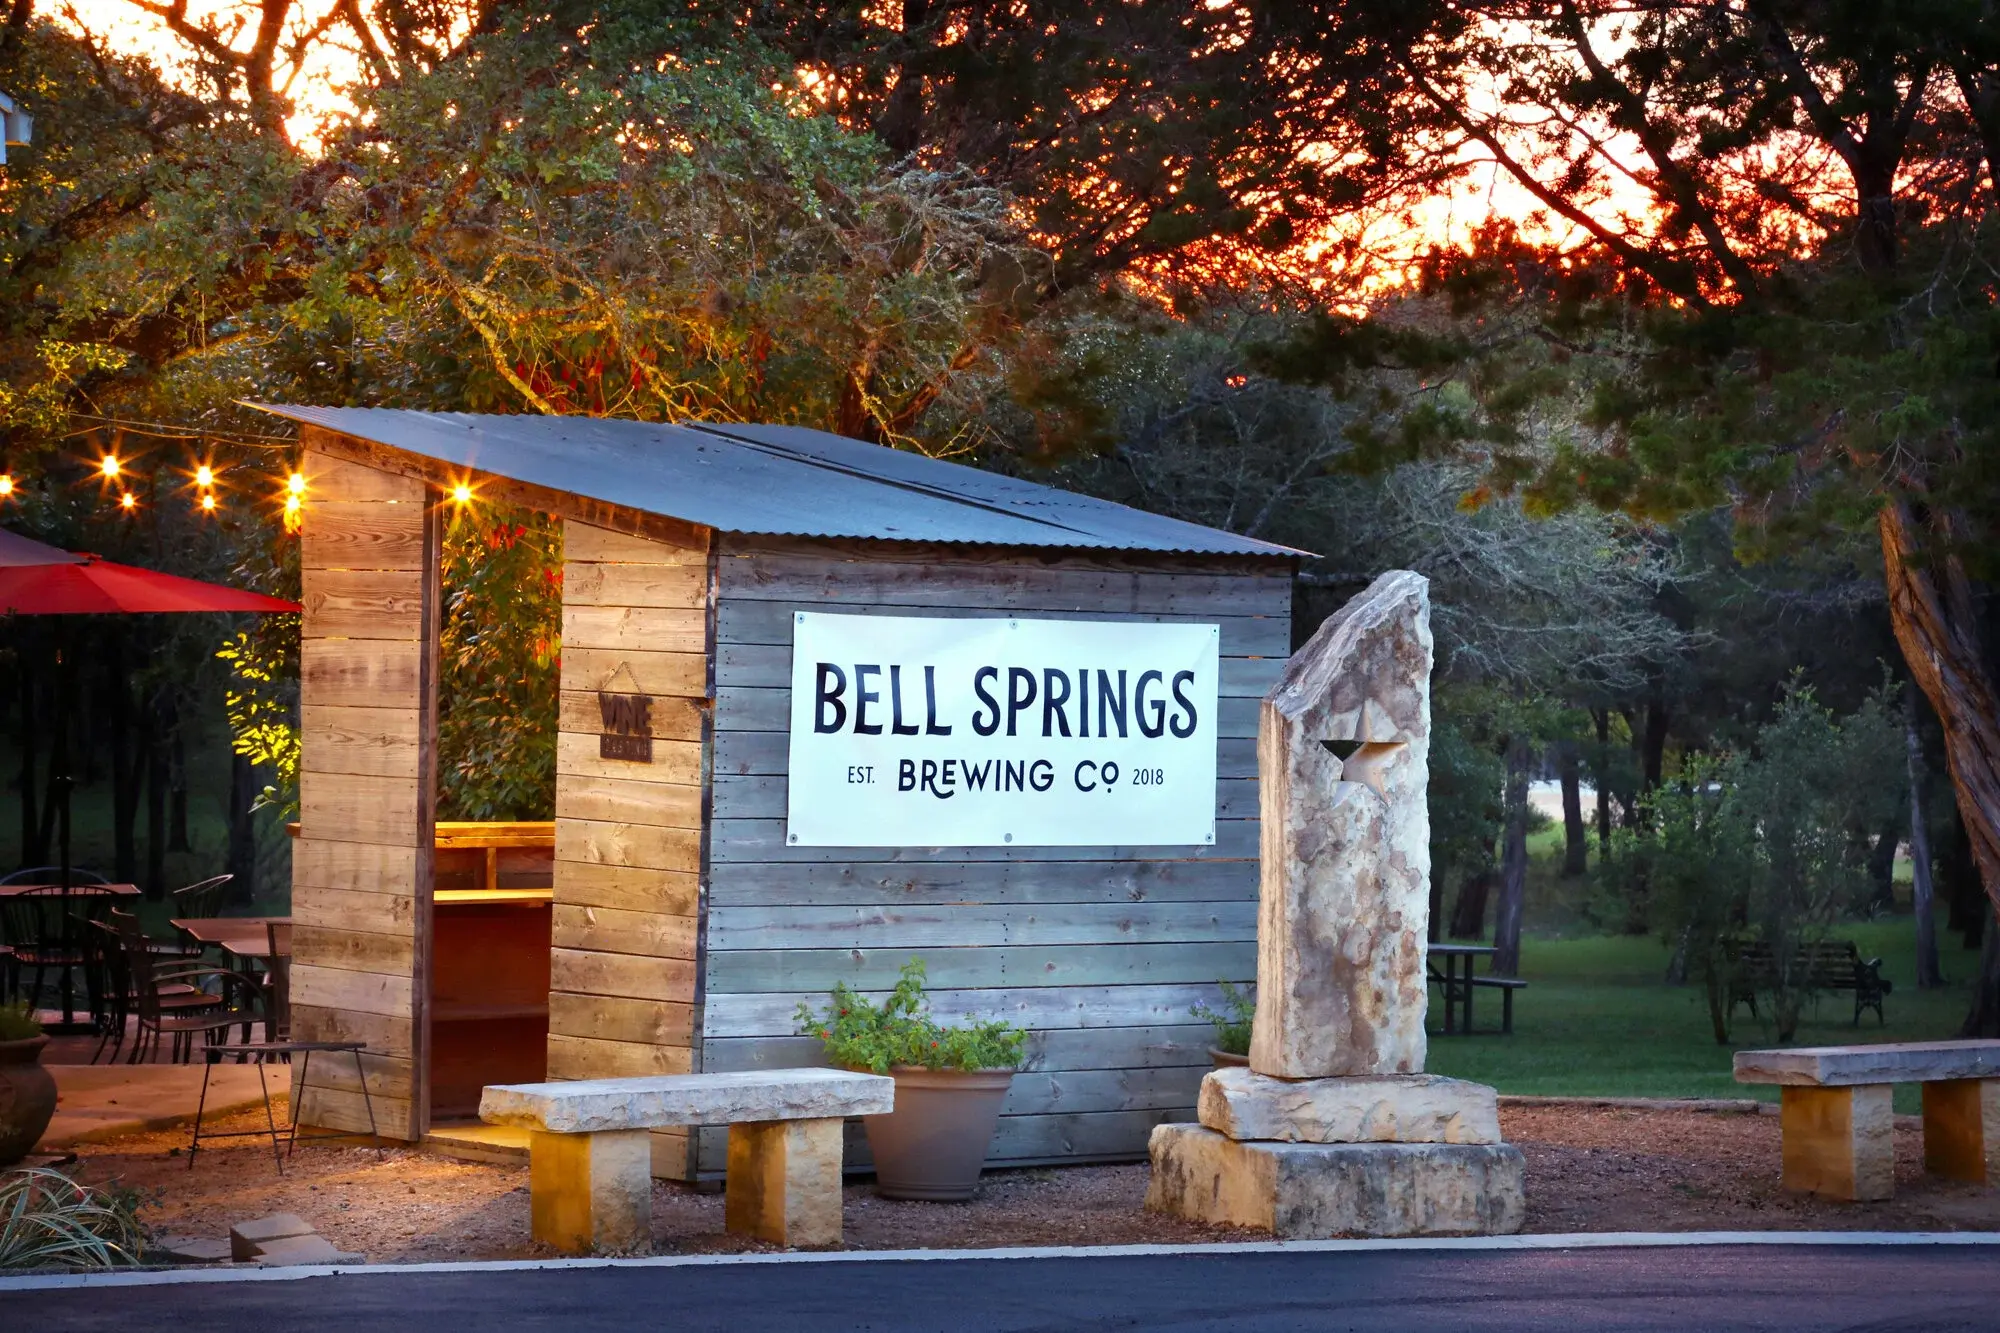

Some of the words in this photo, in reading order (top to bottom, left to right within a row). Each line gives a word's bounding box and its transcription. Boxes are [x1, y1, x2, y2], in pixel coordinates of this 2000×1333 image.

[813, 662, 953, 738] BELL
[971, 666, 1198, 739] SPRINGS
[847, 766, 876, 785] EST.
[898, 758, 1055, 800] BREWING
[1132, 768, 1164, 786] 2018
